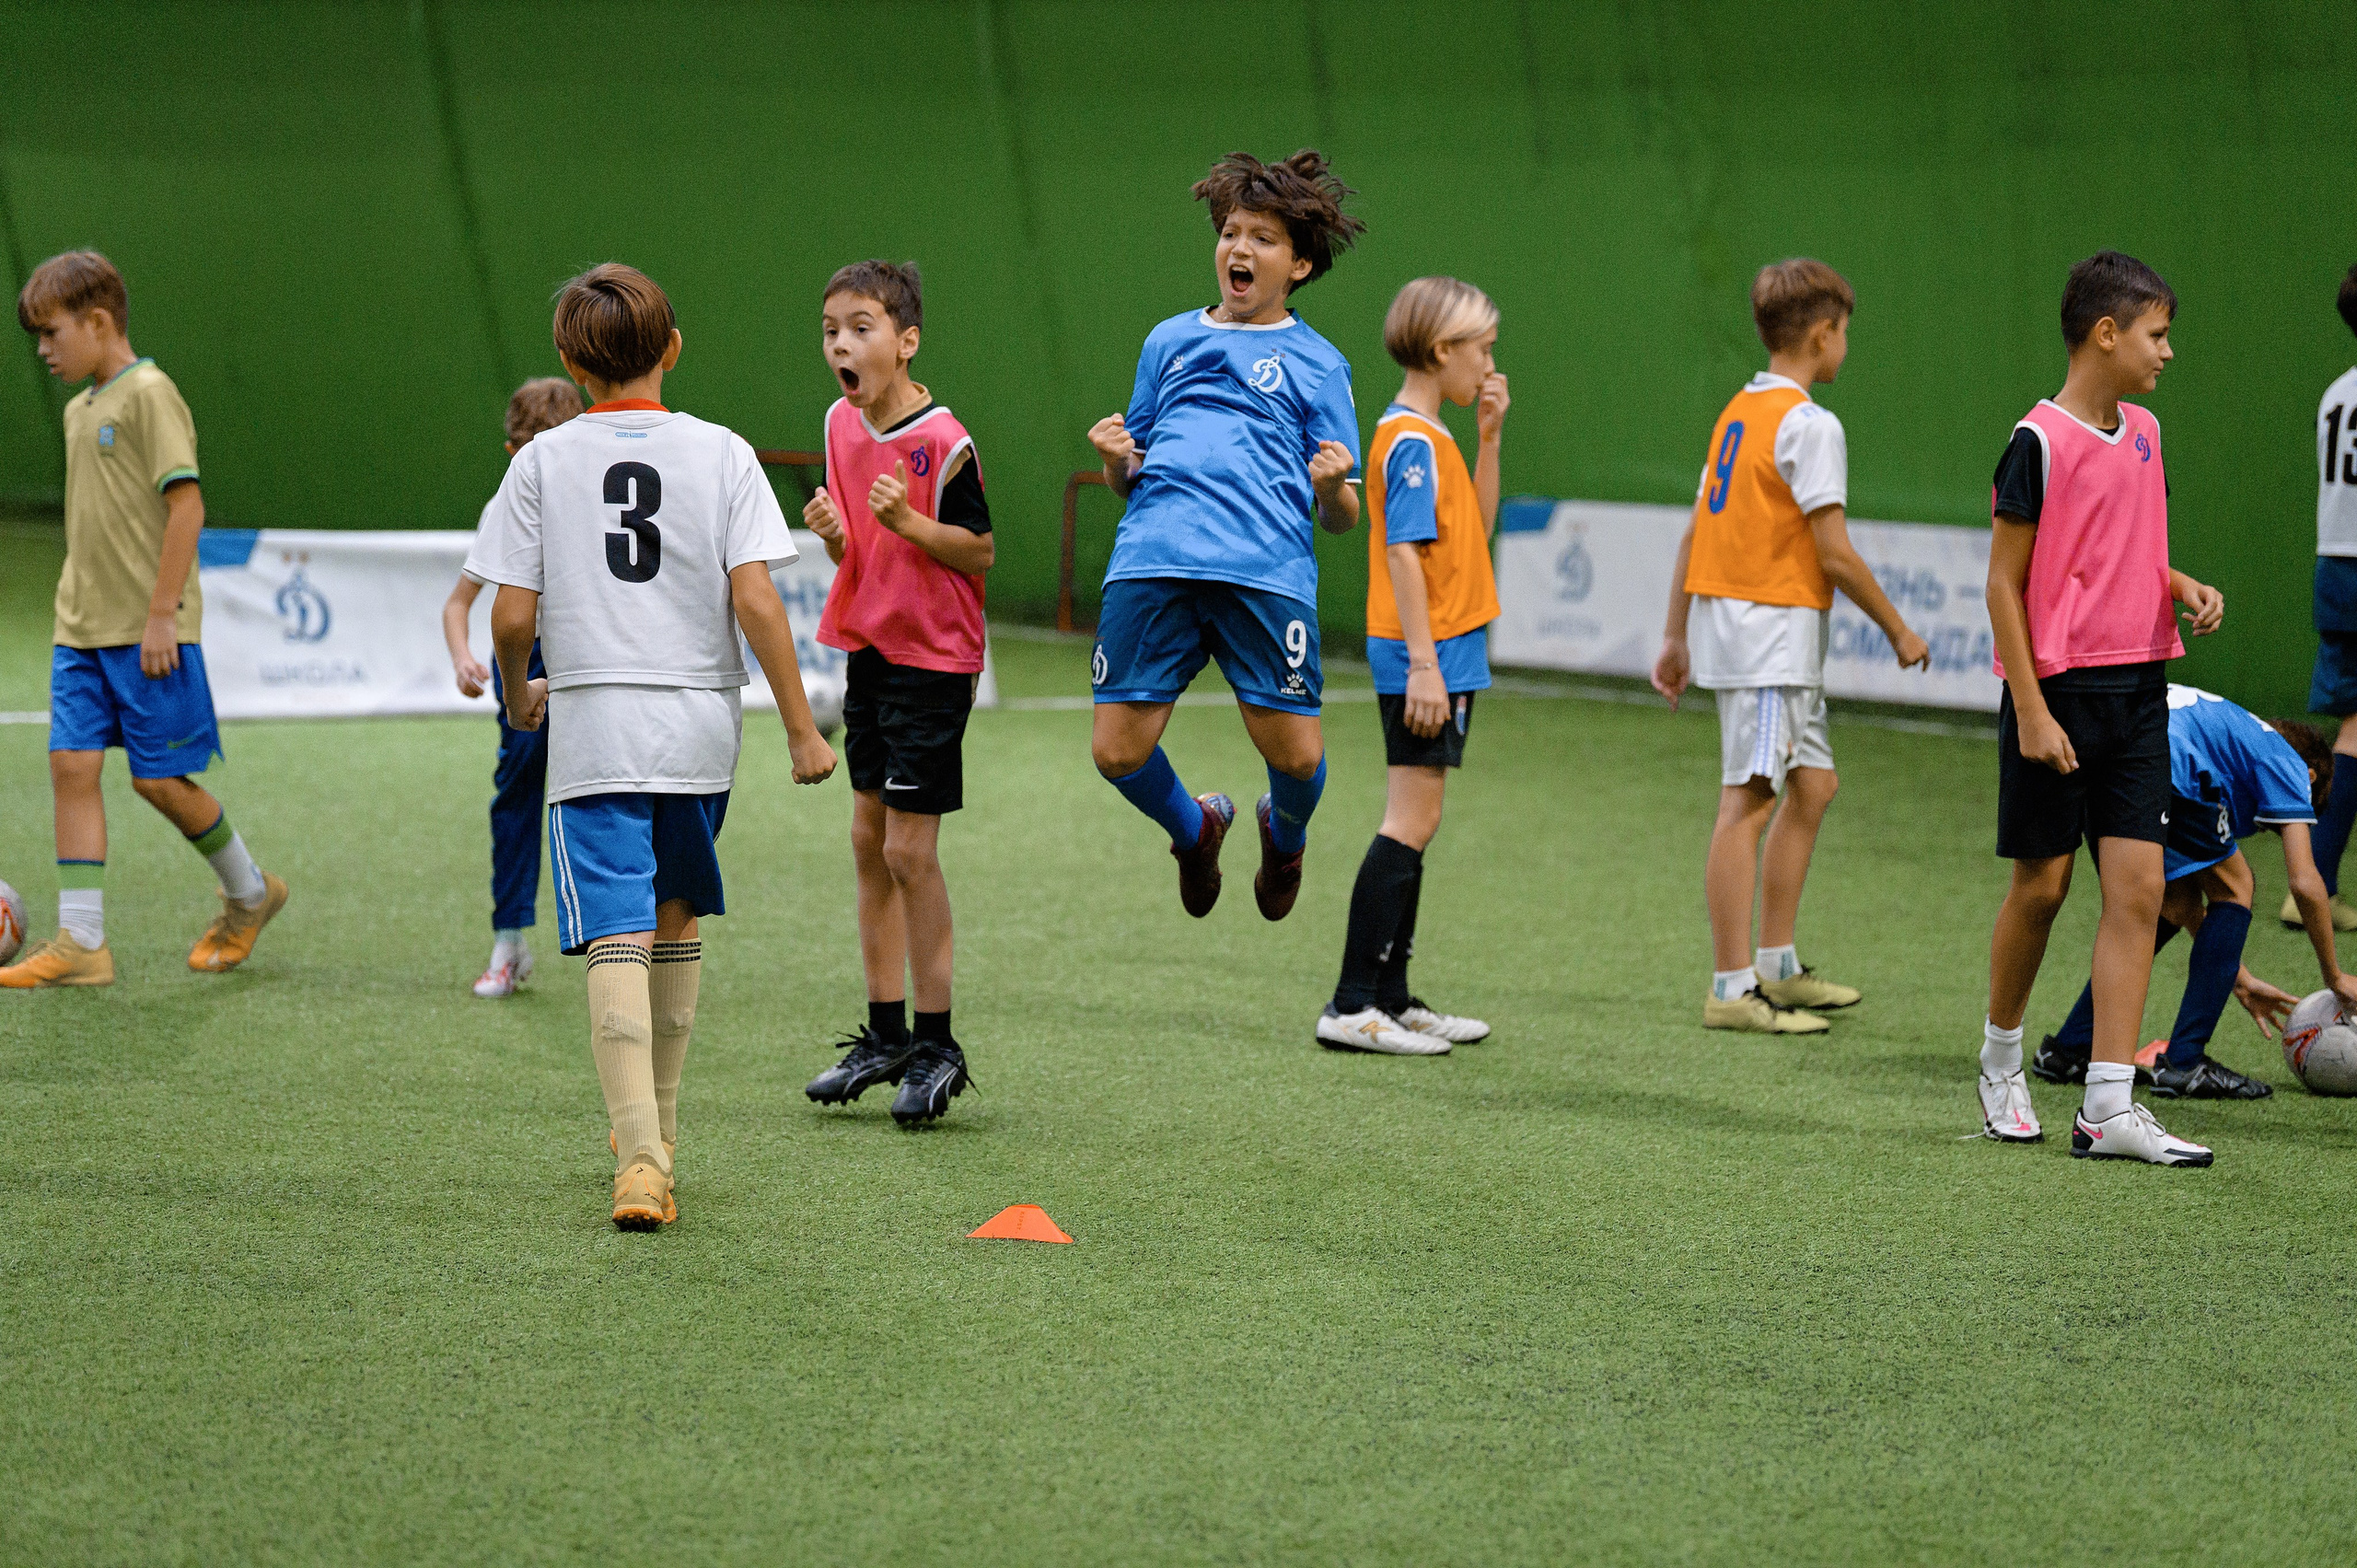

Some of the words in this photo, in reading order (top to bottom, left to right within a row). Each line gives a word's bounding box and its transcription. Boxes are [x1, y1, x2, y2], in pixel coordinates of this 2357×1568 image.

[1708, 420, 1745, 515] 9
[602, 460, 662, 583] 3
[1285, 620, 1307, 669] 9
